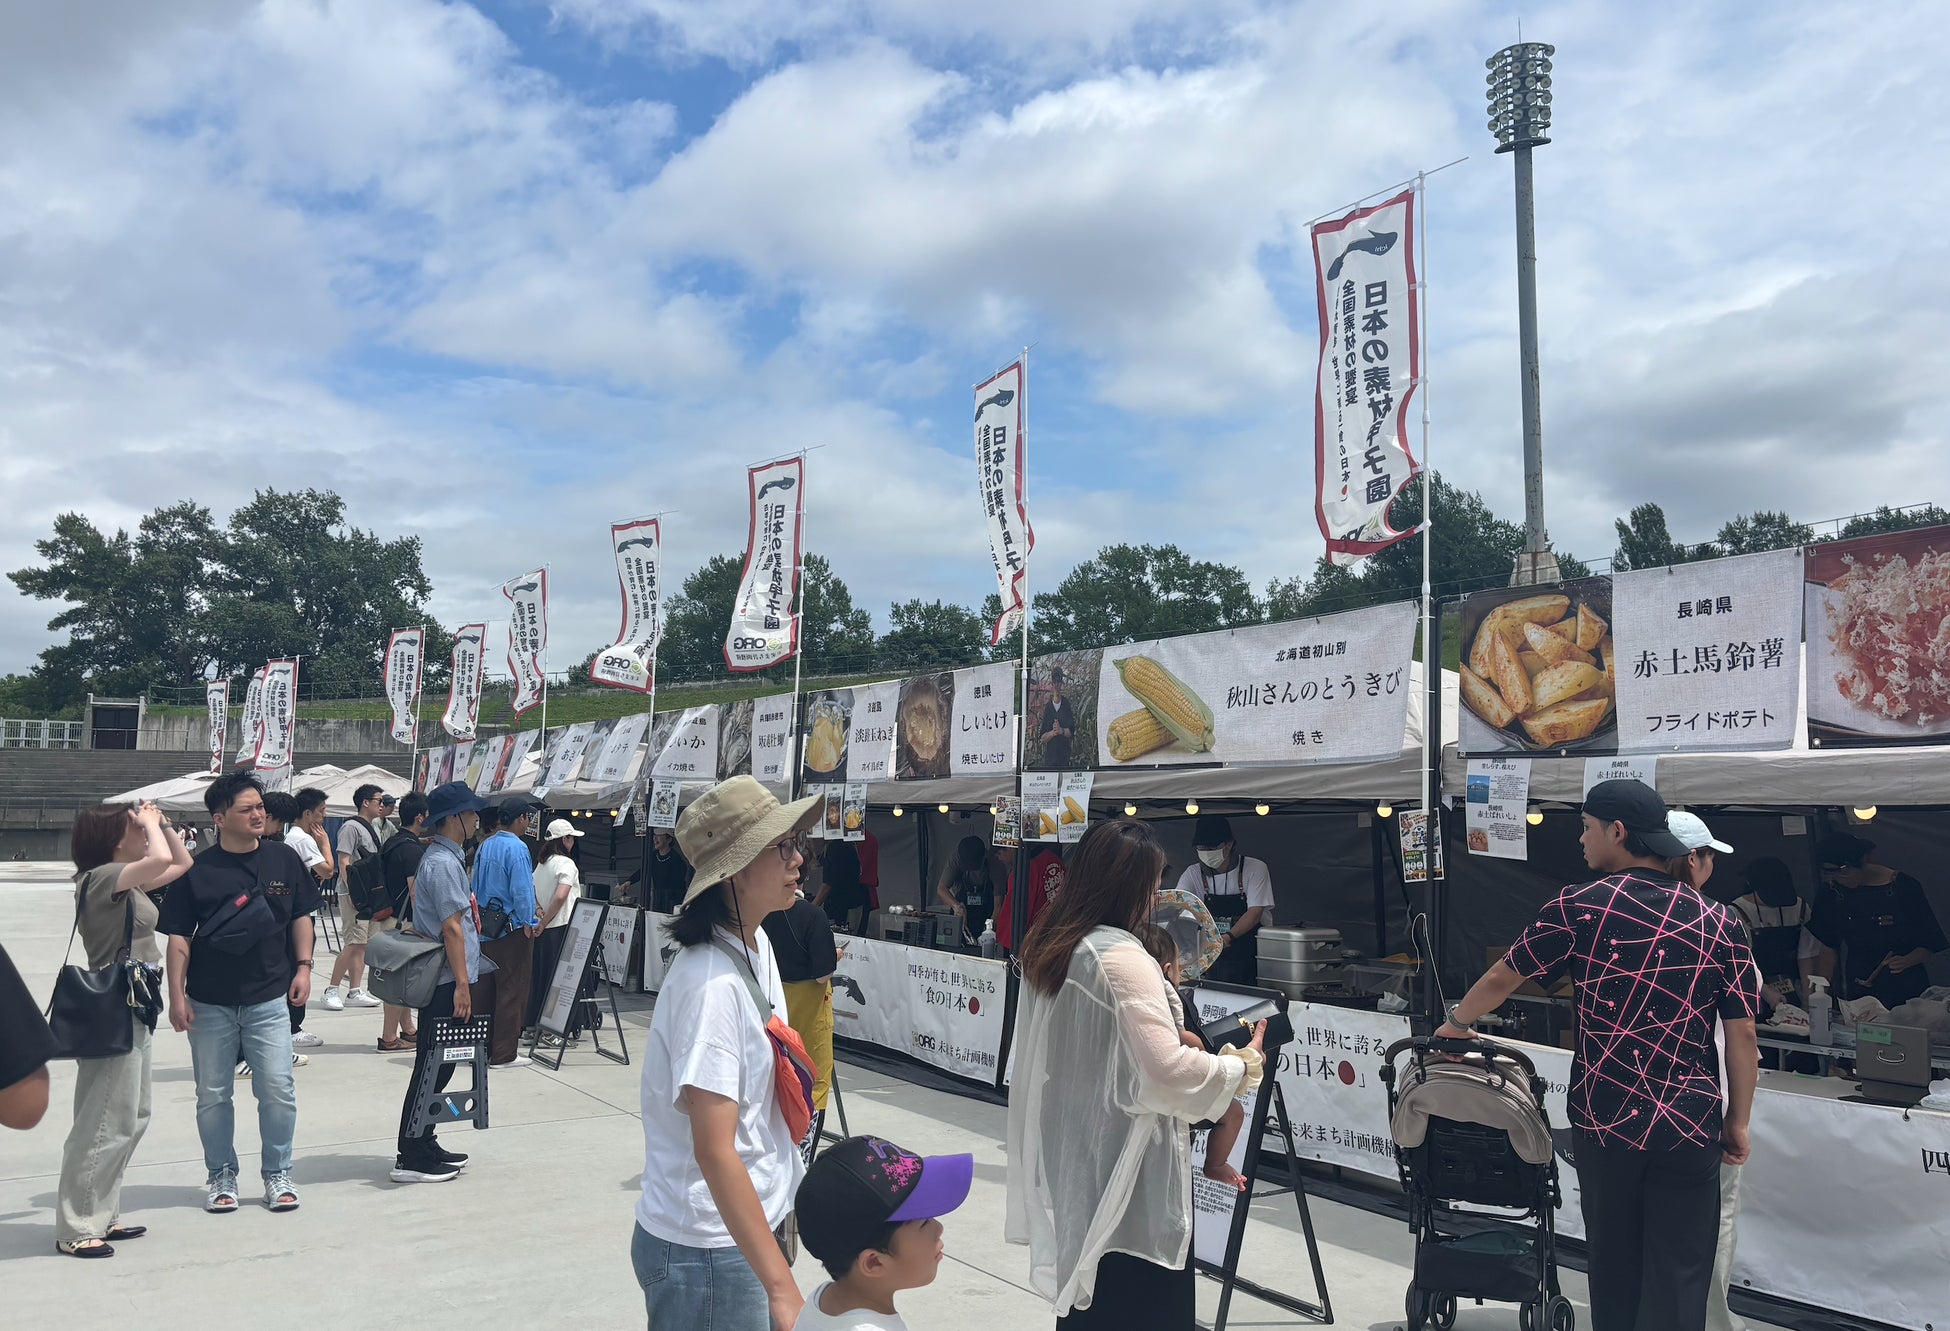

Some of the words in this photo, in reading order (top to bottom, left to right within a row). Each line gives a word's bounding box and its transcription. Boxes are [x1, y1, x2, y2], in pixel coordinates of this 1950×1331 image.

[1676, 596, 1734, 620] 長崎県
[1275, 640, 1347, 663] 北海道初山別
[1632, 637, 1785, 681] 赤土馬鈴薯
[1226, 667, 1403, 710] 秋山さんのとうきび
[961, 710, 1008, 732] しいたけ
[1645, 708, 1776, 733] フライドポテト
[1291, 729, 1325, 746] 焼き
[666, 762, 696, 773] イカ焼き
[1611, 760, 1629, 769] 長崎県
[1488, 804, 1504, 812] 長崎県
[918, 1033, 936, 1051] ORG
